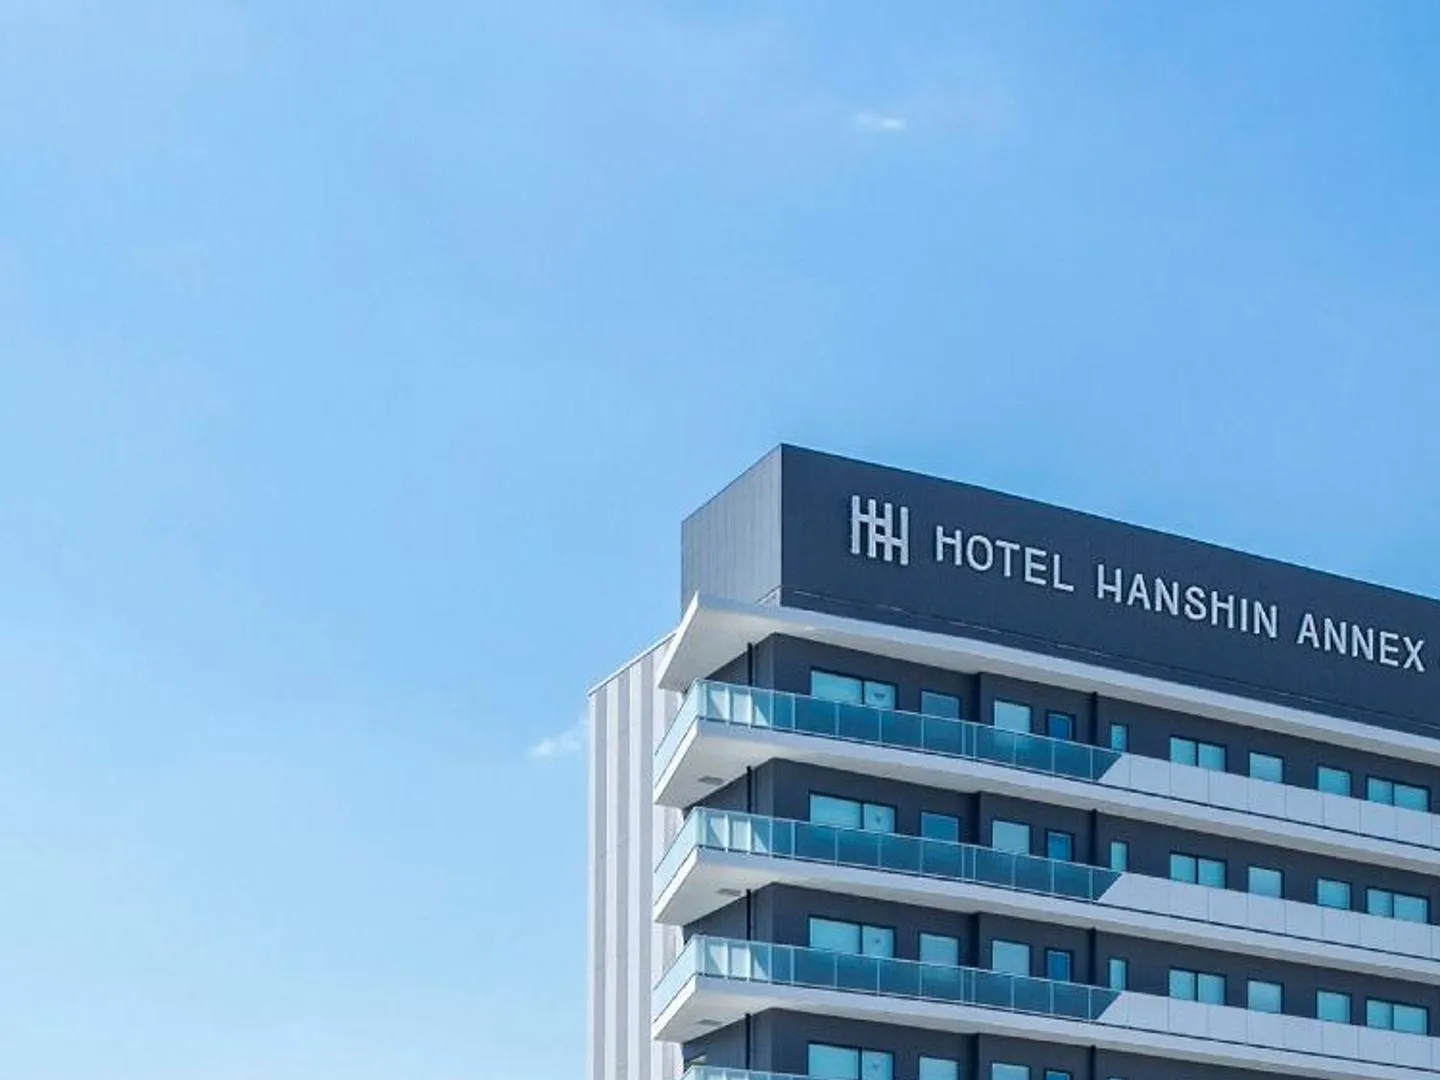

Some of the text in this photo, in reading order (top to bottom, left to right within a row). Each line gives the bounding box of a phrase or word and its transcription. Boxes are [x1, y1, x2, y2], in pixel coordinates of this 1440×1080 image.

[936, 525, 1074, 592] HOTEL
[1097, 564, 1277, 639] HANSHIN
[1297, 613, 1425, 673] ANNEX
